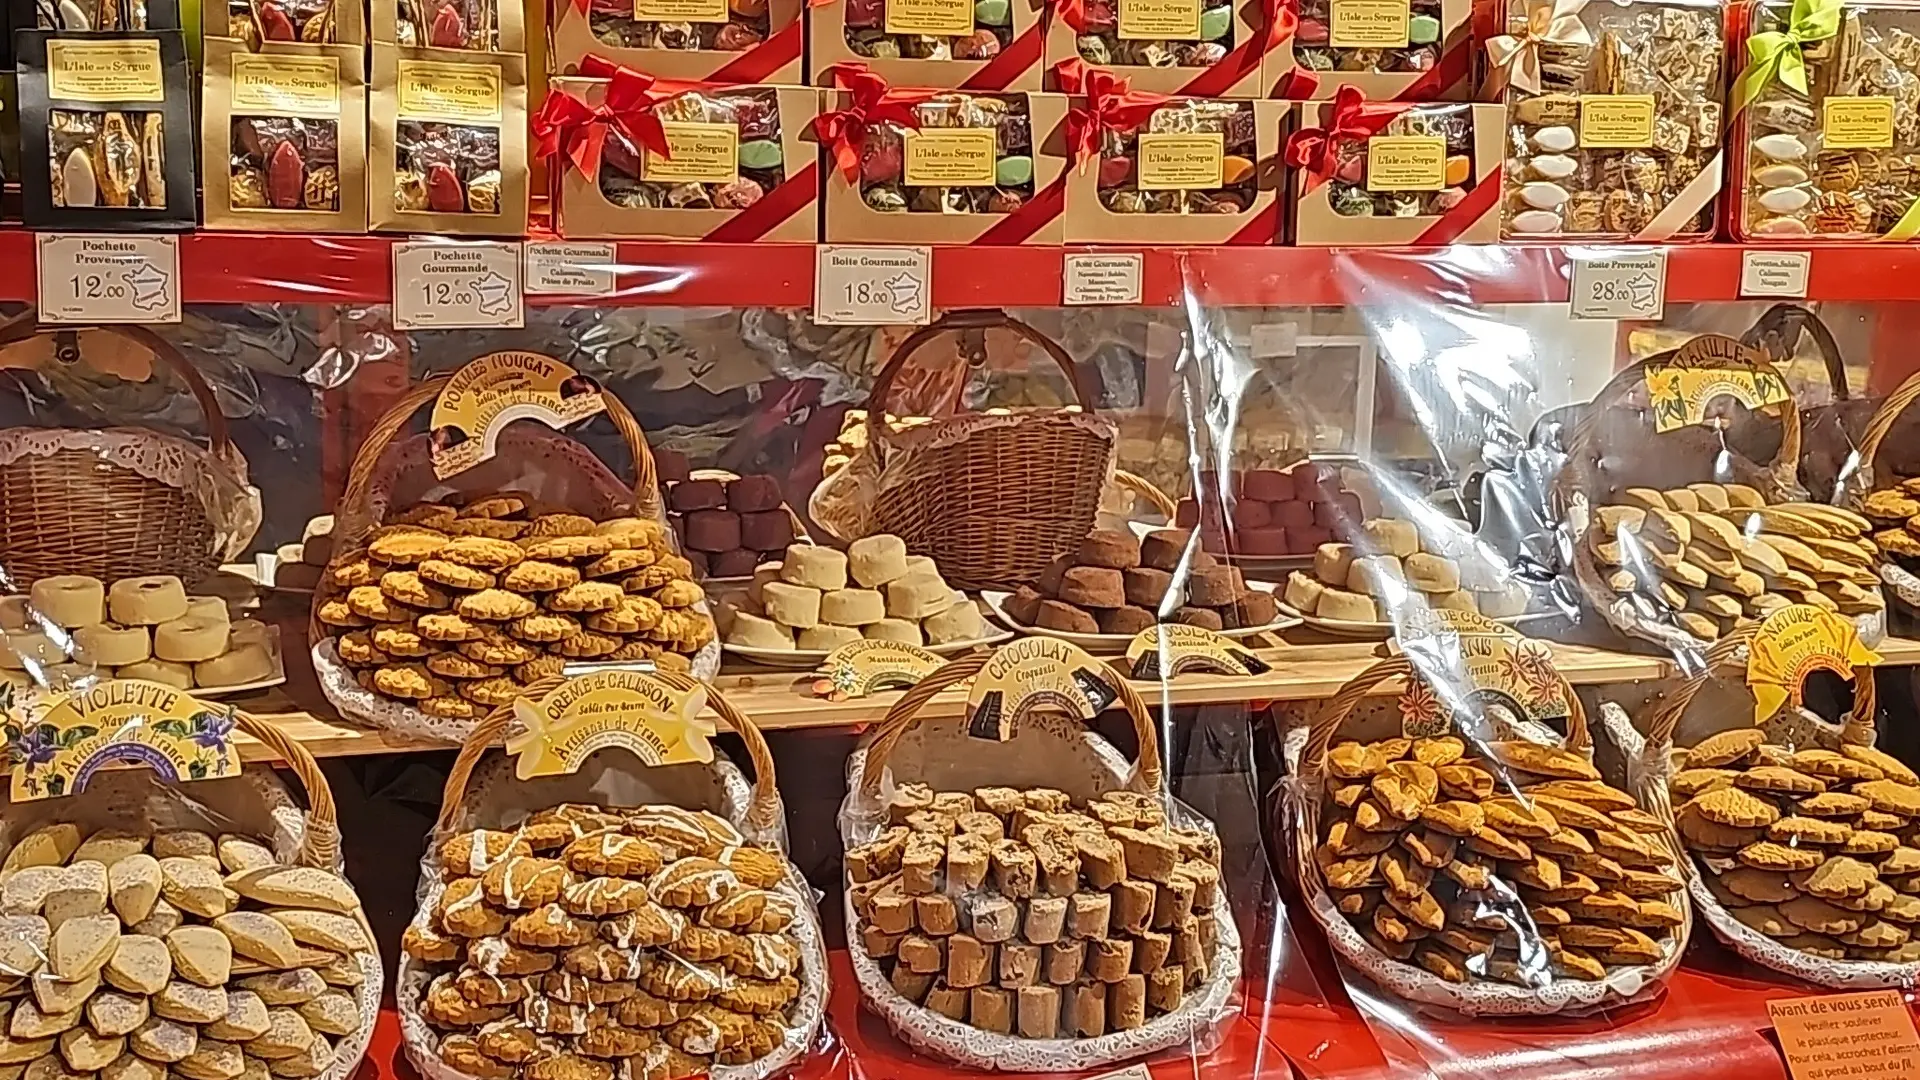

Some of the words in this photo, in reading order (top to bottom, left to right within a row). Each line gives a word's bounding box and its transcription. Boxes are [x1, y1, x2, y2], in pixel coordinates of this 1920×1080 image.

[1164, 3, 1192, 14] Sorgue
[64, 61, 94, 72] L'Isle
[113, 61, 151, 72] Sorgue
[245, 76, 274, 86] L'Isle
[291, 78, 328, 88] Sorgue
[455, 85, 490, 96] Sorgue
[695, 143, 728, 154] Sorgue
[954, 148, 986, 159] Sorgue
[1186, 154, 1214, 164] Sorgue
[1412, 155, 1438, 165] Sorgue
[82, 240, 136, 252] Pochette
[433, 250, 482, 260] Pochette
[529, 247, 562, 256] Pochette
[564, 248, 610, 257] Gourmande
[422, 263, 488, 273] Gourmande
[860, 256, 918, 266] Gourmande
[1612, 260, 1656, 270] Provençale
[1672, 338, 1746, 374] VANILLE
[443, 360, 488, 412] POMMES
[491, 353, 555, 378] NOUGAT
[528, 388, 567, 416] France
[1437, 610, 1458, 622] DE
[1460, 612, 1506, 634] COCO
[1764, 607, 1813, 642] NATURE
[1458, 637, 1493, 660] ANIS
[1818, 640, 1852, 666] France
[988, 639, 1073, 680] CHOCOLAT
[1015, 664, 1056, 683] Croquants
[67, 683, 178, 718] VIOLETTE
[594, 676, 606, 690] de
[608, 672, 675, 714] CALISSON
[1054, 676, 1088, 708] France
[555, 718, 610, 762] Artisanat
[614, 715, 628, 731] de
[633, 717, 670, 757] France
[128, 728, 143, 742] de
[150, 728, 188, 770] France
[1770, 1001, 1808, 1016] Avant
[1810, 1000, 1828, 1014] de
[1828, 1000, 1862, 1012] vous
[1864, 994, 1899, 1008] servir
[1803, 1020, 1840, 1032] Veuillez
[1842, 1016, 1882, 1028] soulever
[1796, 1038, 1807, 1048] le
[1808, 1034, 1849, 1048] plastique
[1851, 1030, 1902, 1044] protecteur.
[1788, 1054, 1810, 1064] Pour
[1812, 1052, 1835, 1062] cela,
[1836, 1048, 1880, 1059] accrochez
[1808, 1067, 1824, 1078] qui
[1826, 1066, 1848, 1079] pend
[1851, 1066, 1862, 1074] au
[1864, 1062, 1886, 1072] bout
[1888, 1060, 1900, 1070] du
